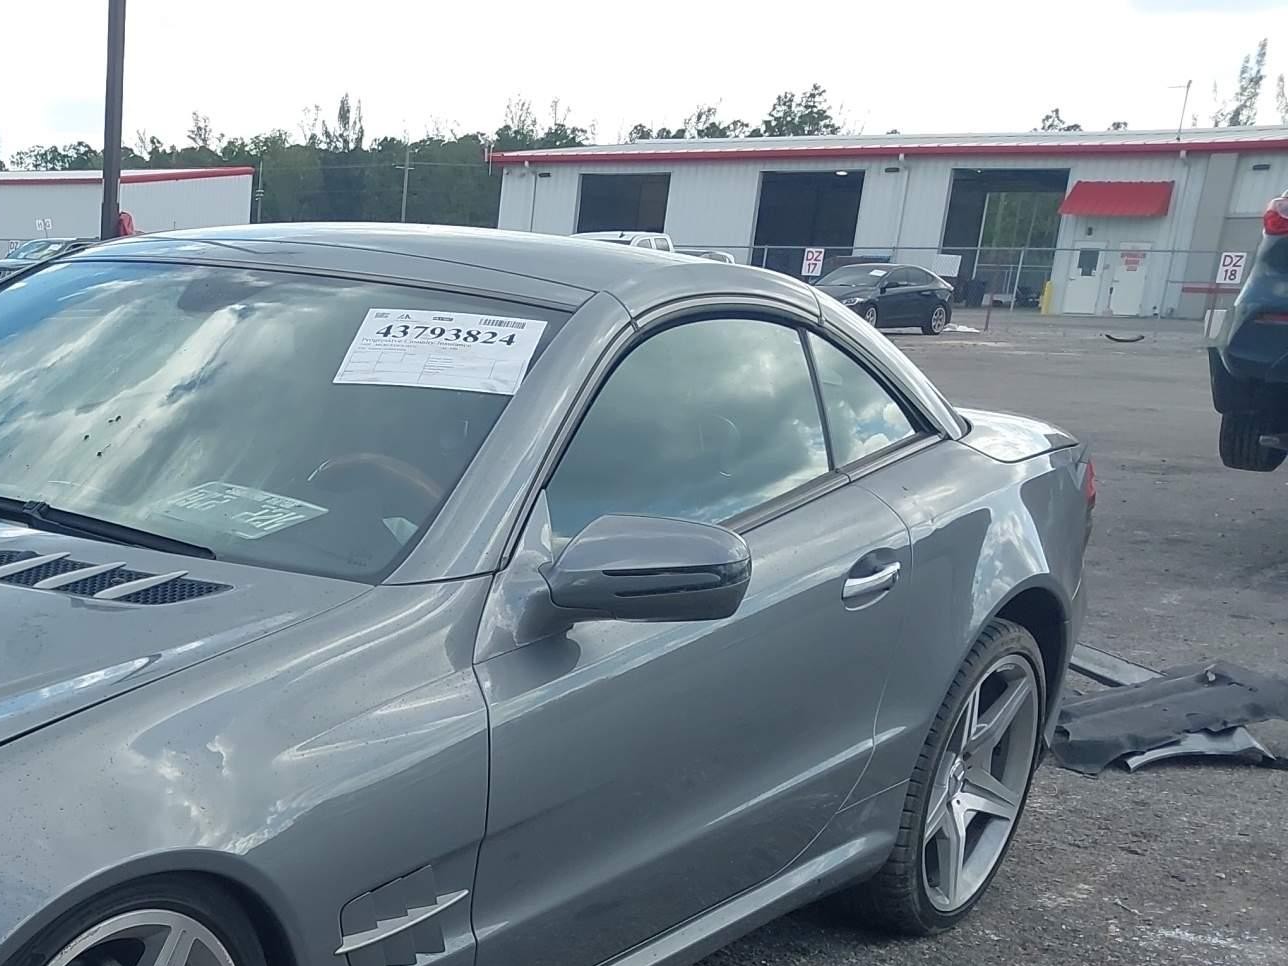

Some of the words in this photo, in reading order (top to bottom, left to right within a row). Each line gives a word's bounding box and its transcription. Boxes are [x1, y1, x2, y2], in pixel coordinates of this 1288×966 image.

[806, 251, 822, 261] DZ
[1222, 255, 1244, 267] DZ
[807, 263, 818, 273] 17
[1223, 269, 1238, 281] 18
[376, 323, 516, 346] 43793824
